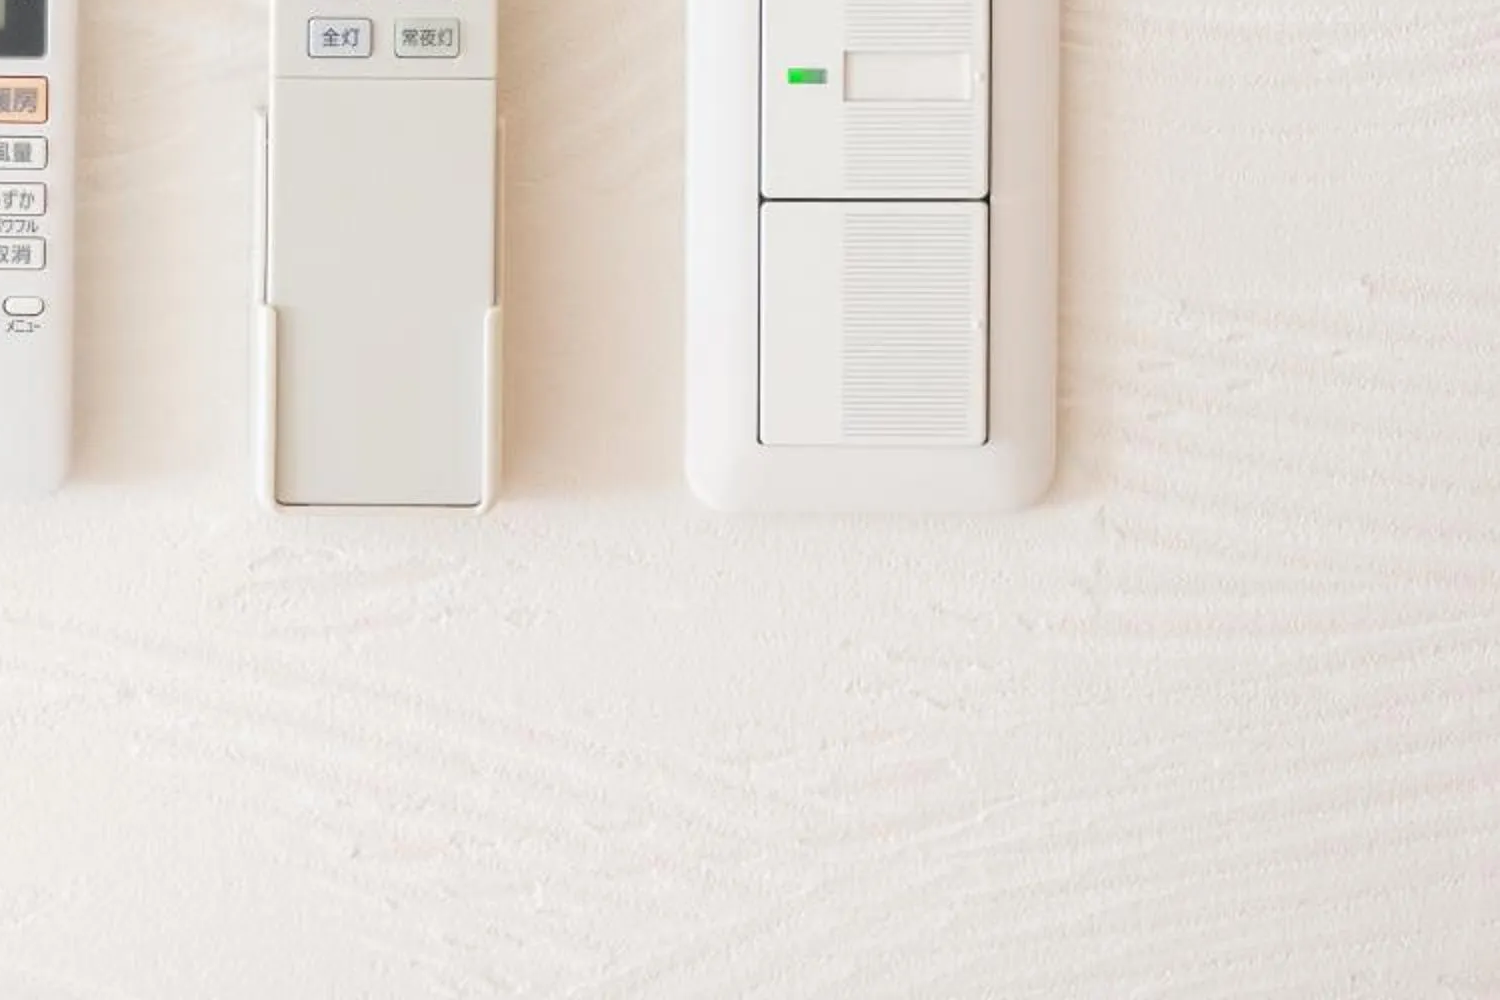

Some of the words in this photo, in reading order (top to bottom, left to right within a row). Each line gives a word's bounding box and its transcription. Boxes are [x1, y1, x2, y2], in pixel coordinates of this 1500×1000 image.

[323, 27, 360, 48] 全灯
[402, 29, 453, 48] 常夜灯
[5, 319, 41, 333] メニュー
